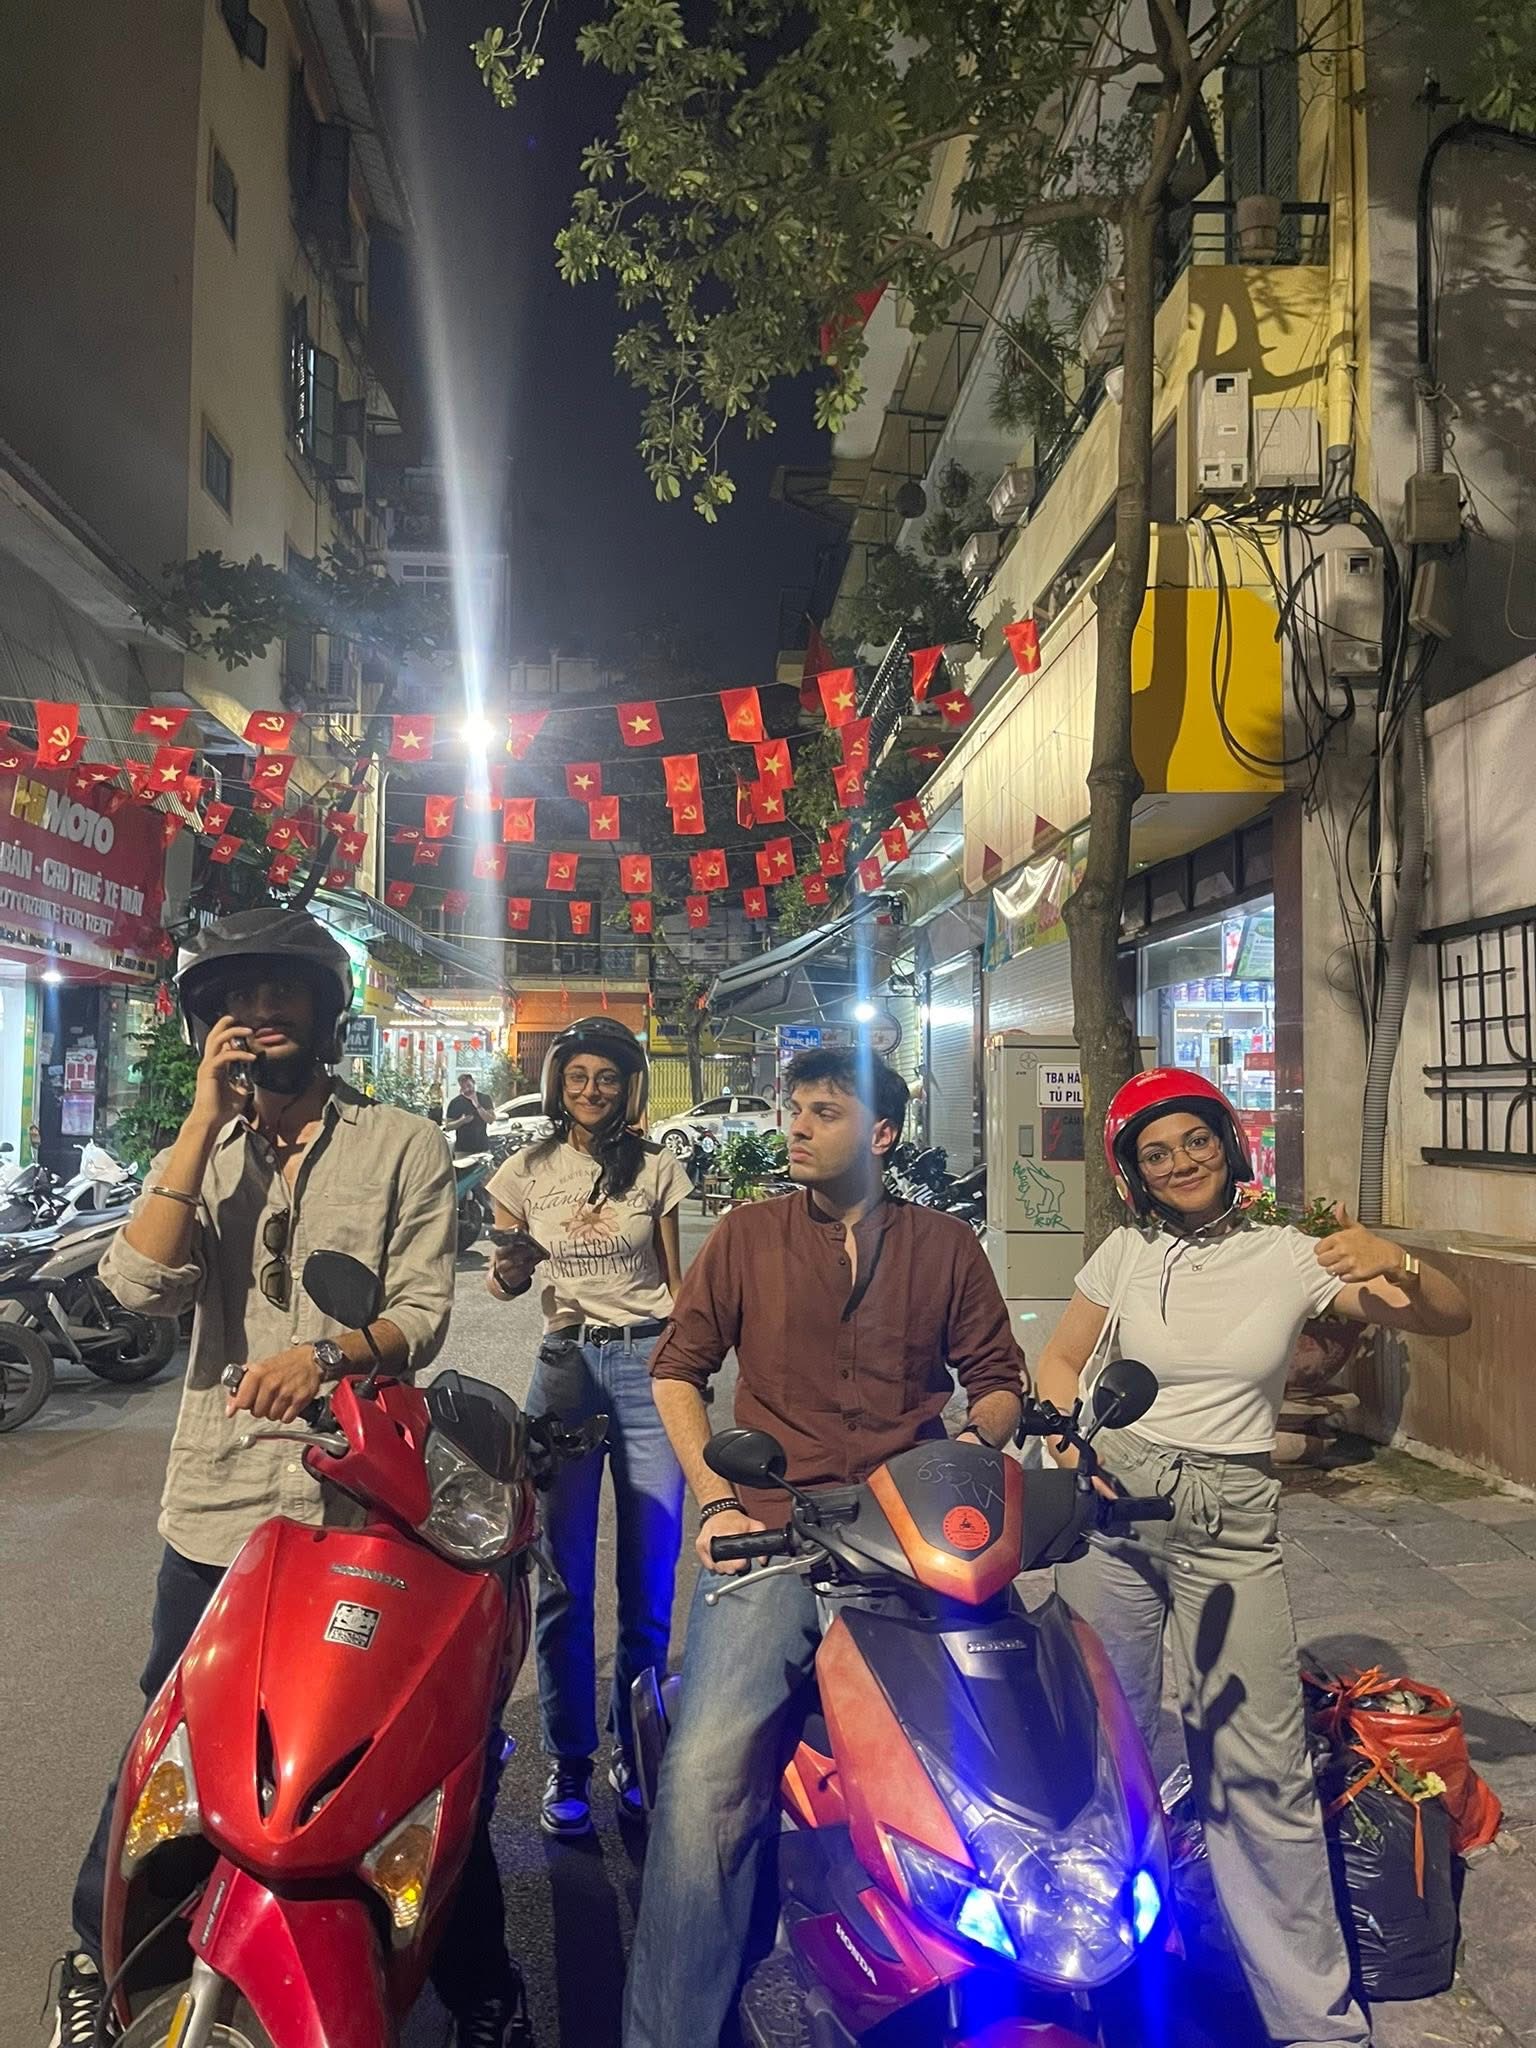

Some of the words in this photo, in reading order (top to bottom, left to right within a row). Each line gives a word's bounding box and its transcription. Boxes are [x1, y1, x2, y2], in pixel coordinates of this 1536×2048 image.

[42, 857, 70, 893] CHO
[104, 880, 119, 909] XE
[62, 906, 84, 929] FOR
[86, 912, 114, 937] RENT
[1045, 1072, 1064, 1084] TBA
[1067, 1070, 1081, 1084] HÀ
[1049, 1086, 1062, 1102] TỦ
[1066, 1091, 1082, 1102] PIL
[550, 1240, 567, 1260] LE
[836, 1921, 878, 1986] HONDA
